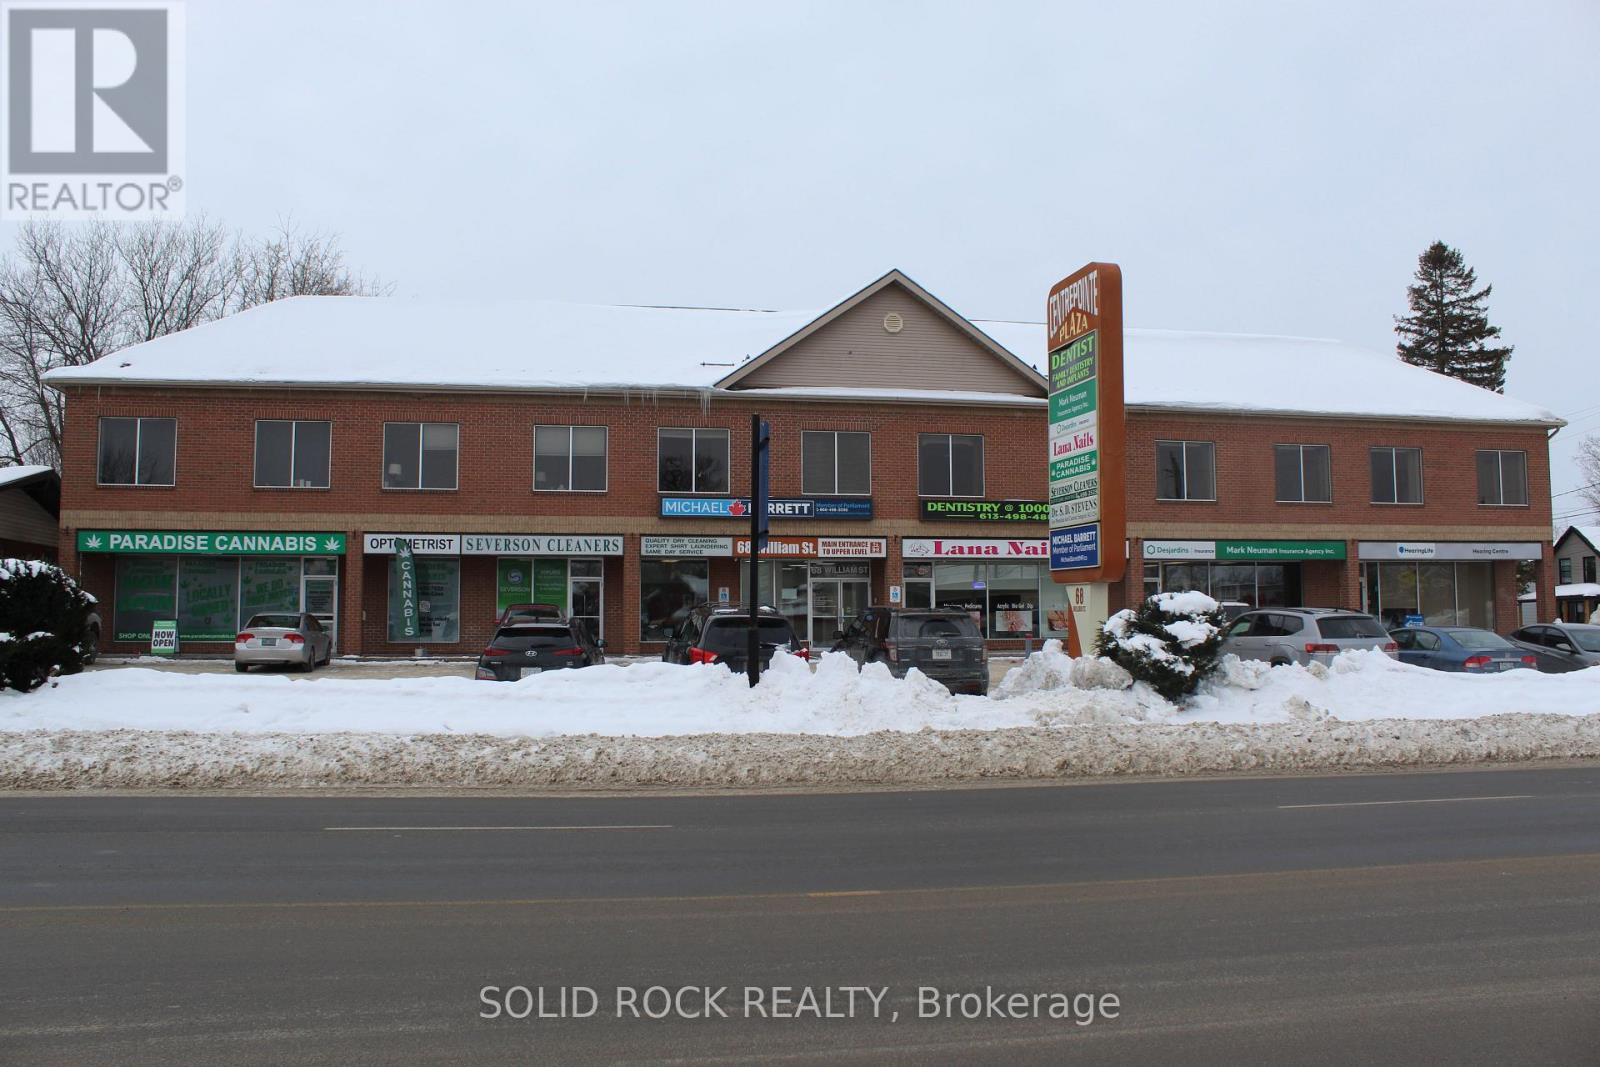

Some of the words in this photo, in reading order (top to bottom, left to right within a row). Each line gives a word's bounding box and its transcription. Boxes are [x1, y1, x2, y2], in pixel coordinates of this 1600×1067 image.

[1059, 311, 1089, 342] PLAZA
[1052, 336, 1095, 370] DENTIST
[1052, 369, 1069, 382] FAMILY
[1069, 356, 1094, 374] DENTISTRY
[1056, 377, 1067, 389] AND
[1067, 368, 1090, 385] IMPLANTS
[1053, 442, 1072, 456] Lana
[1073, 432, 1094, 450] Nails
[1056, 454, 1091, 470] PARADISE
[1056, 463, 1091, 478] CANNABIS
[1073, 478, 1098, 492] CLEANERS
[664, 502, 726, 513] MICHAEL
[927, 502, 1001, 512] DENTISTRY
[1005, 503, 1014, 512] @
[1018, 503, 1050, 513] 1000
[979, 513, 1049, 521] 613-498-48
[109, 534, 209, 550] PARADISE
[215, 535, 317, 551] CANNABIS
[466, 539, 542, 551] SEVERSON
[547, 538, 619, 552] CLEANERS
[1052, 533, 1073, 545] MICHAEL
[1073, 531, 1097, 543] BARRETT
[737, 540, 751, 554] 68
[759, 541, 800, 554] illiam
[801, 541, 817, 554] St.
[933, 540, 999, 556] Lana
[1008, 541, 1047, 556] Nai
[1052, 546, 1069, 555] Member
[1074, 543, 1097, 552] Parliament
[1157, 546, 1189, 557] Desjardins
[1226, 546, 1246, 554] Mark
[1247, 546, 1278, 554] Neuman
[824, 566, 858, 575] WILLIAM
[859, 566, 869, 575] ST
[401, 561, 415, 636] CANNABIS
[1075, 587, 1084, 605] 68
[119, 632, 137, 640] SHOP
[137, 632, 151, 640] ONL
[154, 631, 174, 639] NOW
[152, 639, 174, 648] OPEN
